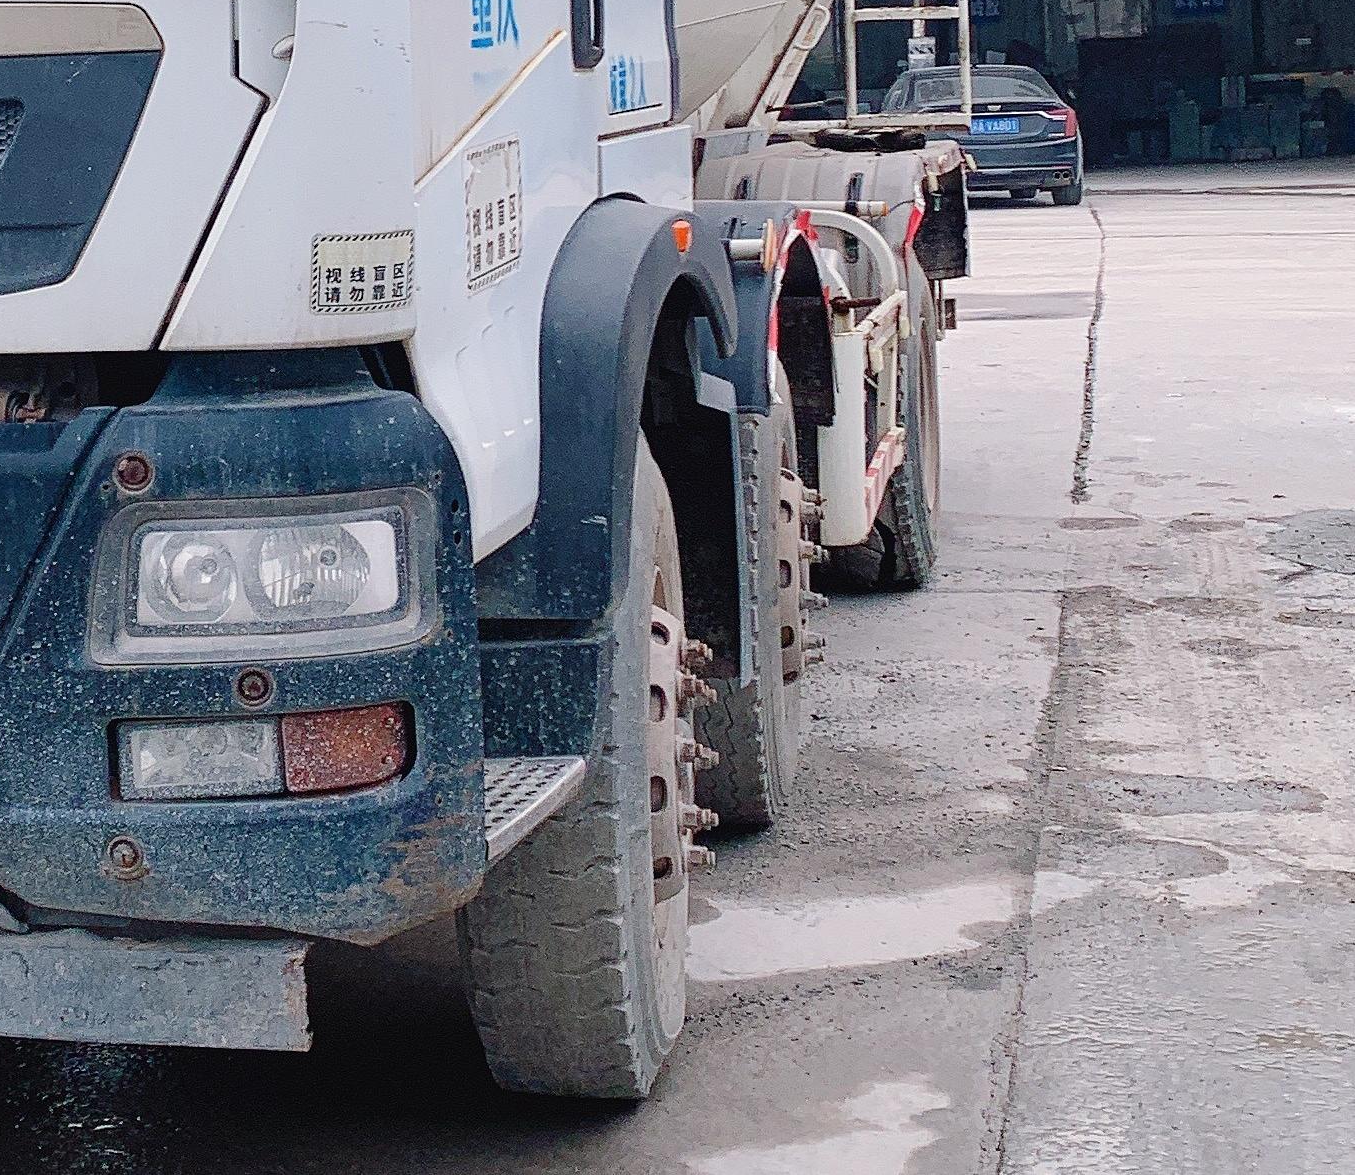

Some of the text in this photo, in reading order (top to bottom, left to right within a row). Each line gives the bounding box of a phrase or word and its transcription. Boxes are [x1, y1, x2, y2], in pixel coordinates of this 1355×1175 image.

[325, 263, 405, 284] 视线盲区
[324, 283, 405, 304] 请勿靠近
